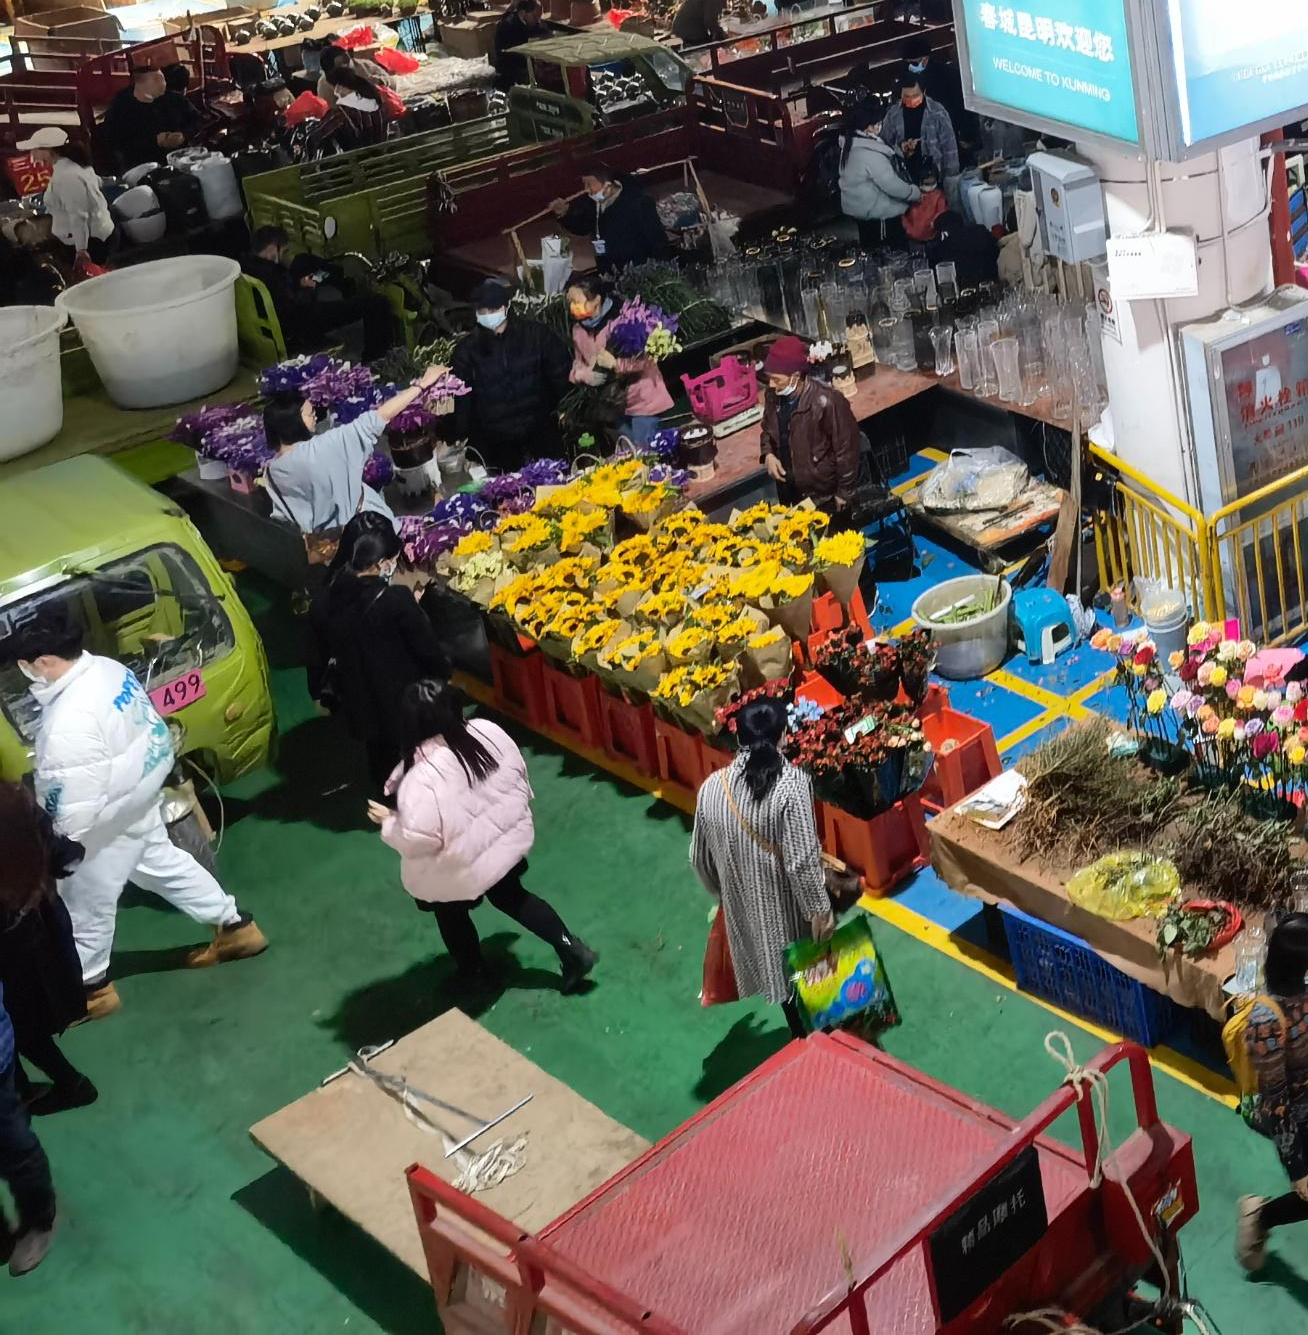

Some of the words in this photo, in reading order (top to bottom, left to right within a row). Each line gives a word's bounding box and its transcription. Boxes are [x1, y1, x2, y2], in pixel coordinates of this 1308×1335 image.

[980, 2, 1114, 62] 春城昆明欢迎您
[993, 56, 1043, 82] WELCOME
[1044, 71, 1060, 87] TO
[1061, 76, 1111, 102] KUNMING
[162, 673, 200, 708] 499
